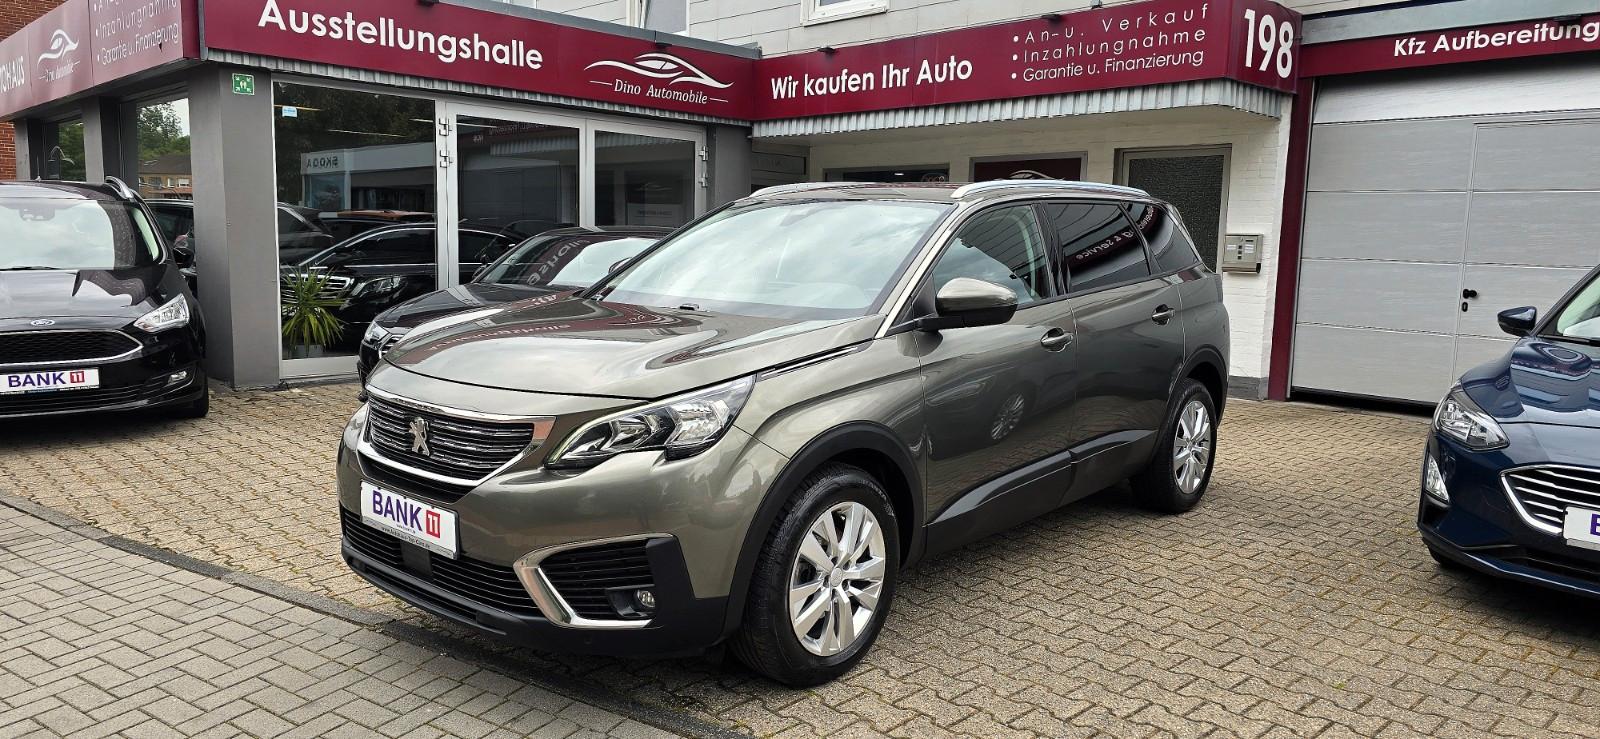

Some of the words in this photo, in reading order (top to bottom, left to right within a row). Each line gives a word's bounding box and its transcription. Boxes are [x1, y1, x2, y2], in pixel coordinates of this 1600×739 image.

[258, 0, 543, 69] Ausstellungshalle
[1102, 3, 1209, 33] Verkauf
[1024, 29, 1206, 63] Inzahlungnahme
[1244, 8, 1294, 79] 198
[1393, 37, 1427, 57] Kfz
[1432, 21, 1600, 53] Aufbereitung
[771, 75, 799, 100] Wir
[804, 68, 875, 97] kaufen
[882, 63, 910, 89] Ihr
[915, 55, 973, 86] Auto
[1023, 62, 1083, 82] Garantie
[1087, 64, 1100, 75] u.
[1105, 50, 1204, 73] Finanzierung
[614, 79, 641, 95] Dino
[646, 84, 708, 105] Automobile
[8, 372, 67, 388] BANK
[372, 490, 423, 532] BANK
[427, 512, 440, 536] 11
